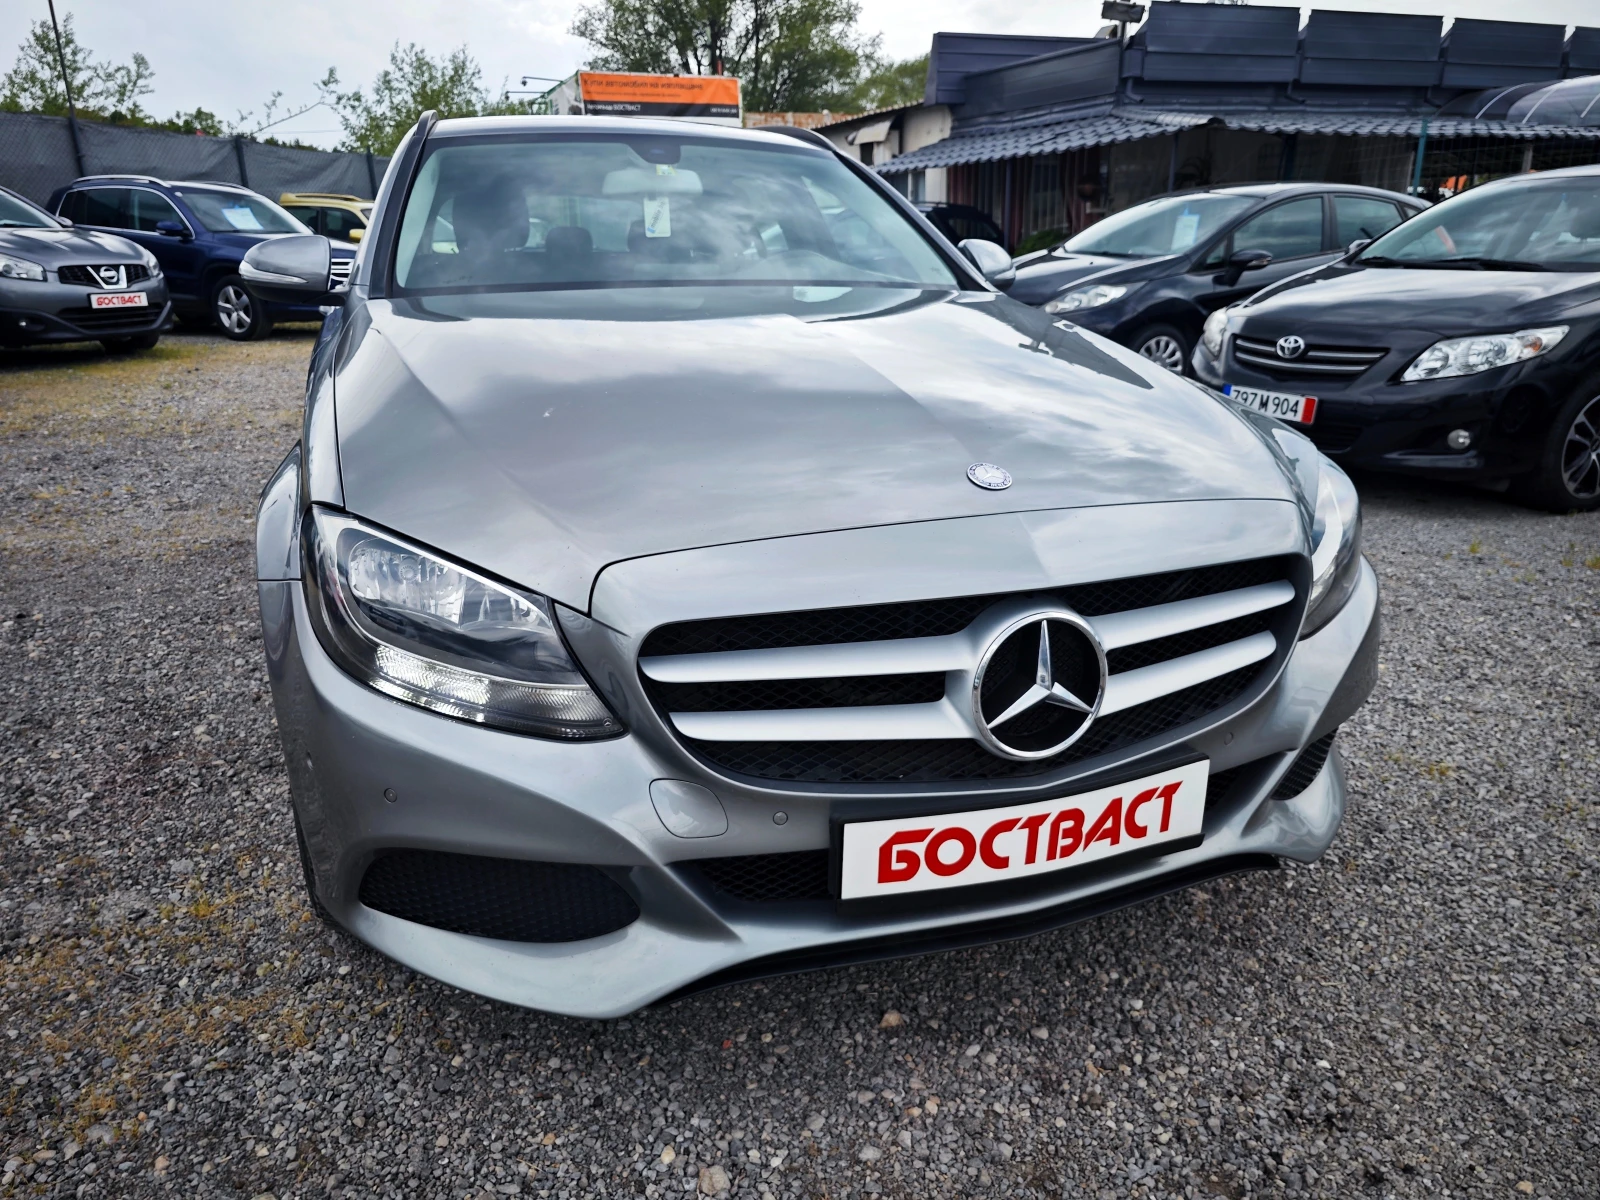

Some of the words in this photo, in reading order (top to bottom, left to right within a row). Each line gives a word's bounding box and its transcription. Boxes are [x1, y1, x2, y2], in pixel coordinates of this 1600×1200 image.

[584, 78, 603, 87] Купи
[606, 80, 647, 88] автомобил
[96, 295, 142, 306] БОСТВАСТ
[877, 780, 1184, 884] БОСТВАСТ
